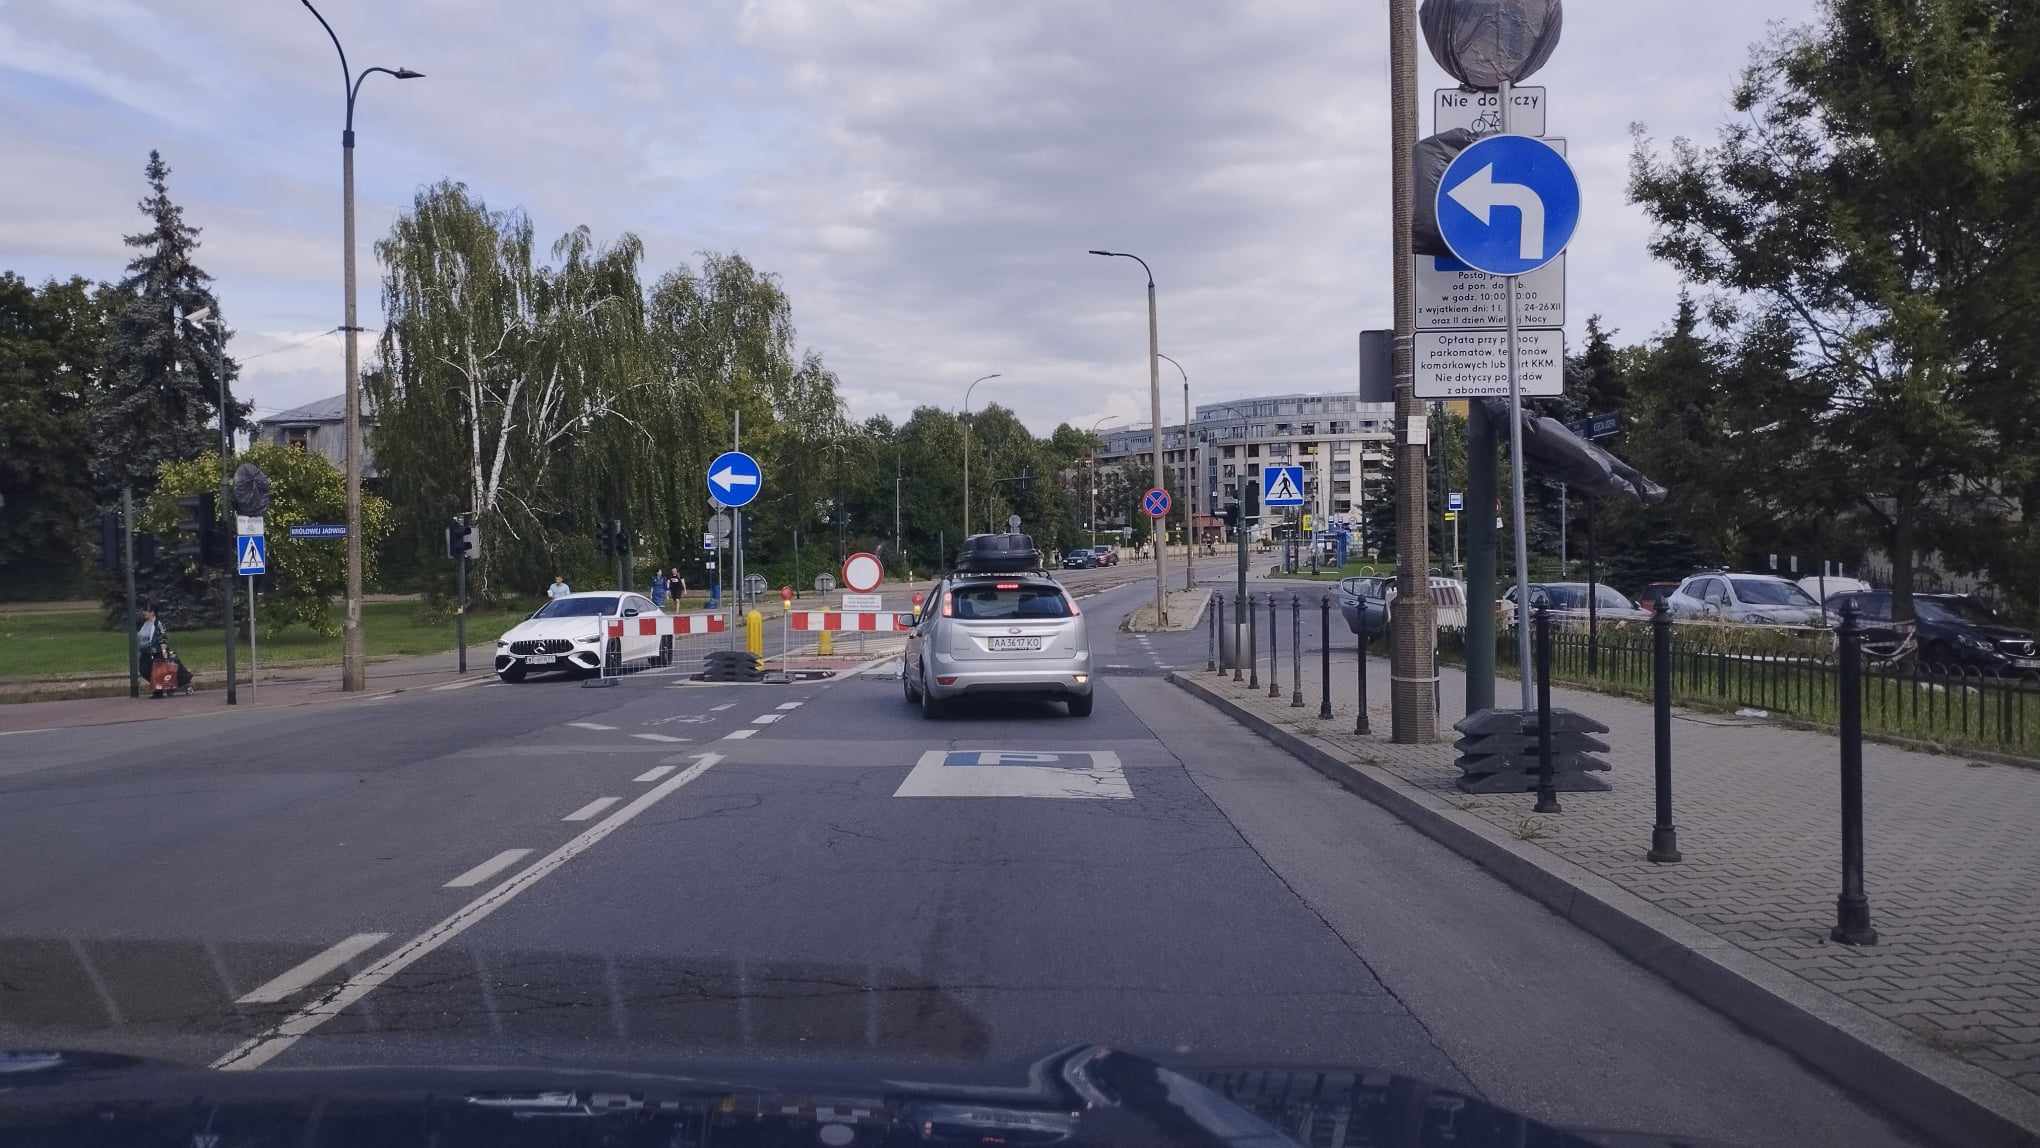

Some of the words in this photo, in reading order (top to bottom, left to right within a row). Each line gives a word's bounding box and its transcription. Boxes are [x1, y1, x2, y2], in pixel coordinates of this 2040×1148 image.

[1441, 94, 1468, 107] Nie
[1477, 92, 1538, 109] doczy
[1525, 314, 1546, 324] Nocy
[1438, 335, 1475, 346] Opłata
[1477, 337, 1497, 345] przy
[1491, 360, 1506, 369] lub
[1435, 373, 1453, 382] Nie
[1454, 373, 1492, 384] dotyczy
